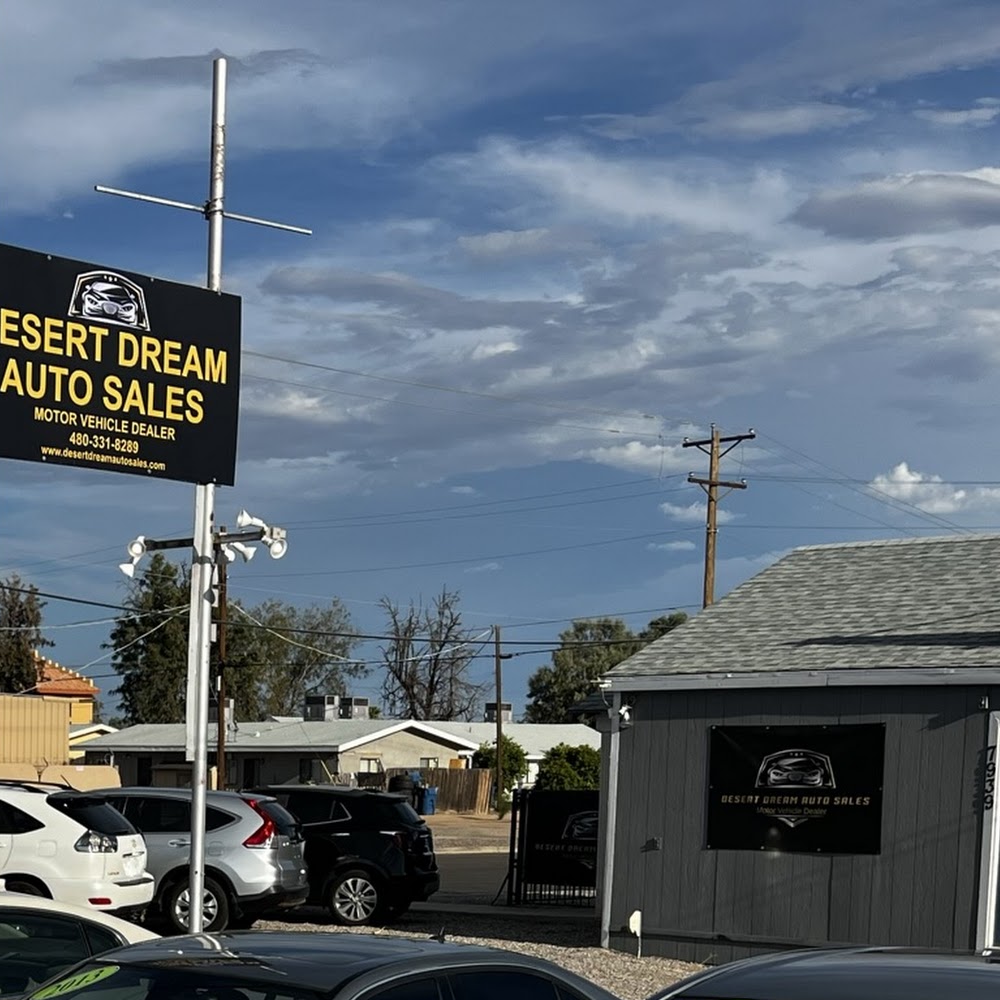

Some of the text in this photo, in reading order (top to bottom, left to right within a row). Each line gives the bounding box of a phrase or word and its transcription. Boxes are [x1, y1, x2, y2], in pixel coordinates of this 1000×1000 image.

[118, 332, 227, 384] DREAM
[0, 358, 204, 424] AUTO SALES
[34, 407, 176, 440] MOTOR VEHICLE DEALER
[41, 446, 166, 471] www.desertdreamautosales.com
[69, 432, 139, 454] 480-331-8289
[983, 745, 996, 810] 7939
[721, 794, 870, 805] DESERT DREAM AUTO SALES
[43, 969, 105, 998] 2013
